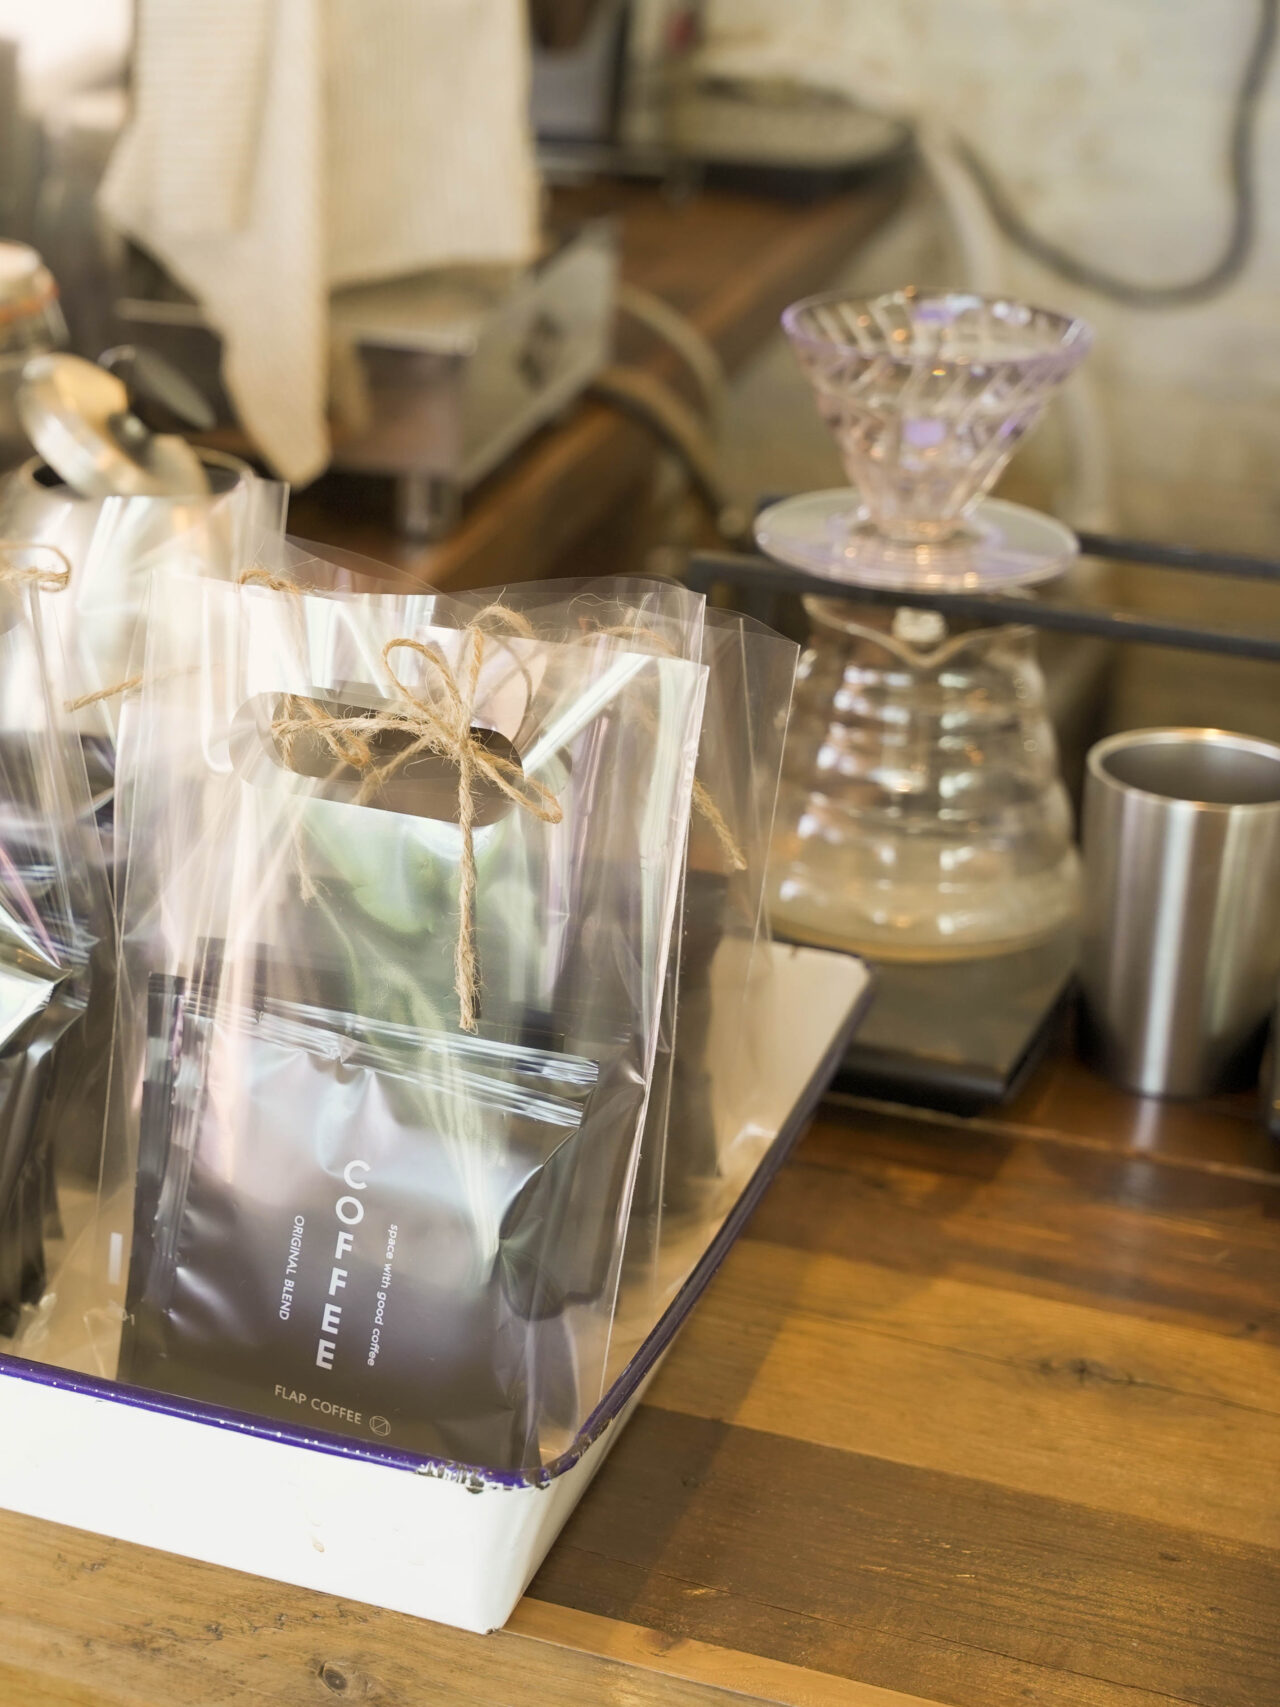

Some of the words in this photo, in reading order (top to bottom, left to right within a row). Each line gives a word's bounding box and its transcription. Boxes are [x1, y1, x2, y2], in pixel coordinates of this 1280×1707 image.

[287, 1215, 305, 1275] ORIGINAL
[386, 1223, 399, 1260] space
[316, 1159, 371, 1370] COFFEE
[379, 1262, 393, 1289] with
[279, 1278, 295, 1321] BLEND
[373, 1290, 388, 1326] good
[366, 1327, 381, 1367] coffee
[274, 1384, 308, 1405] FLAP
[310, 1397, 363, 1425] COFFEE
